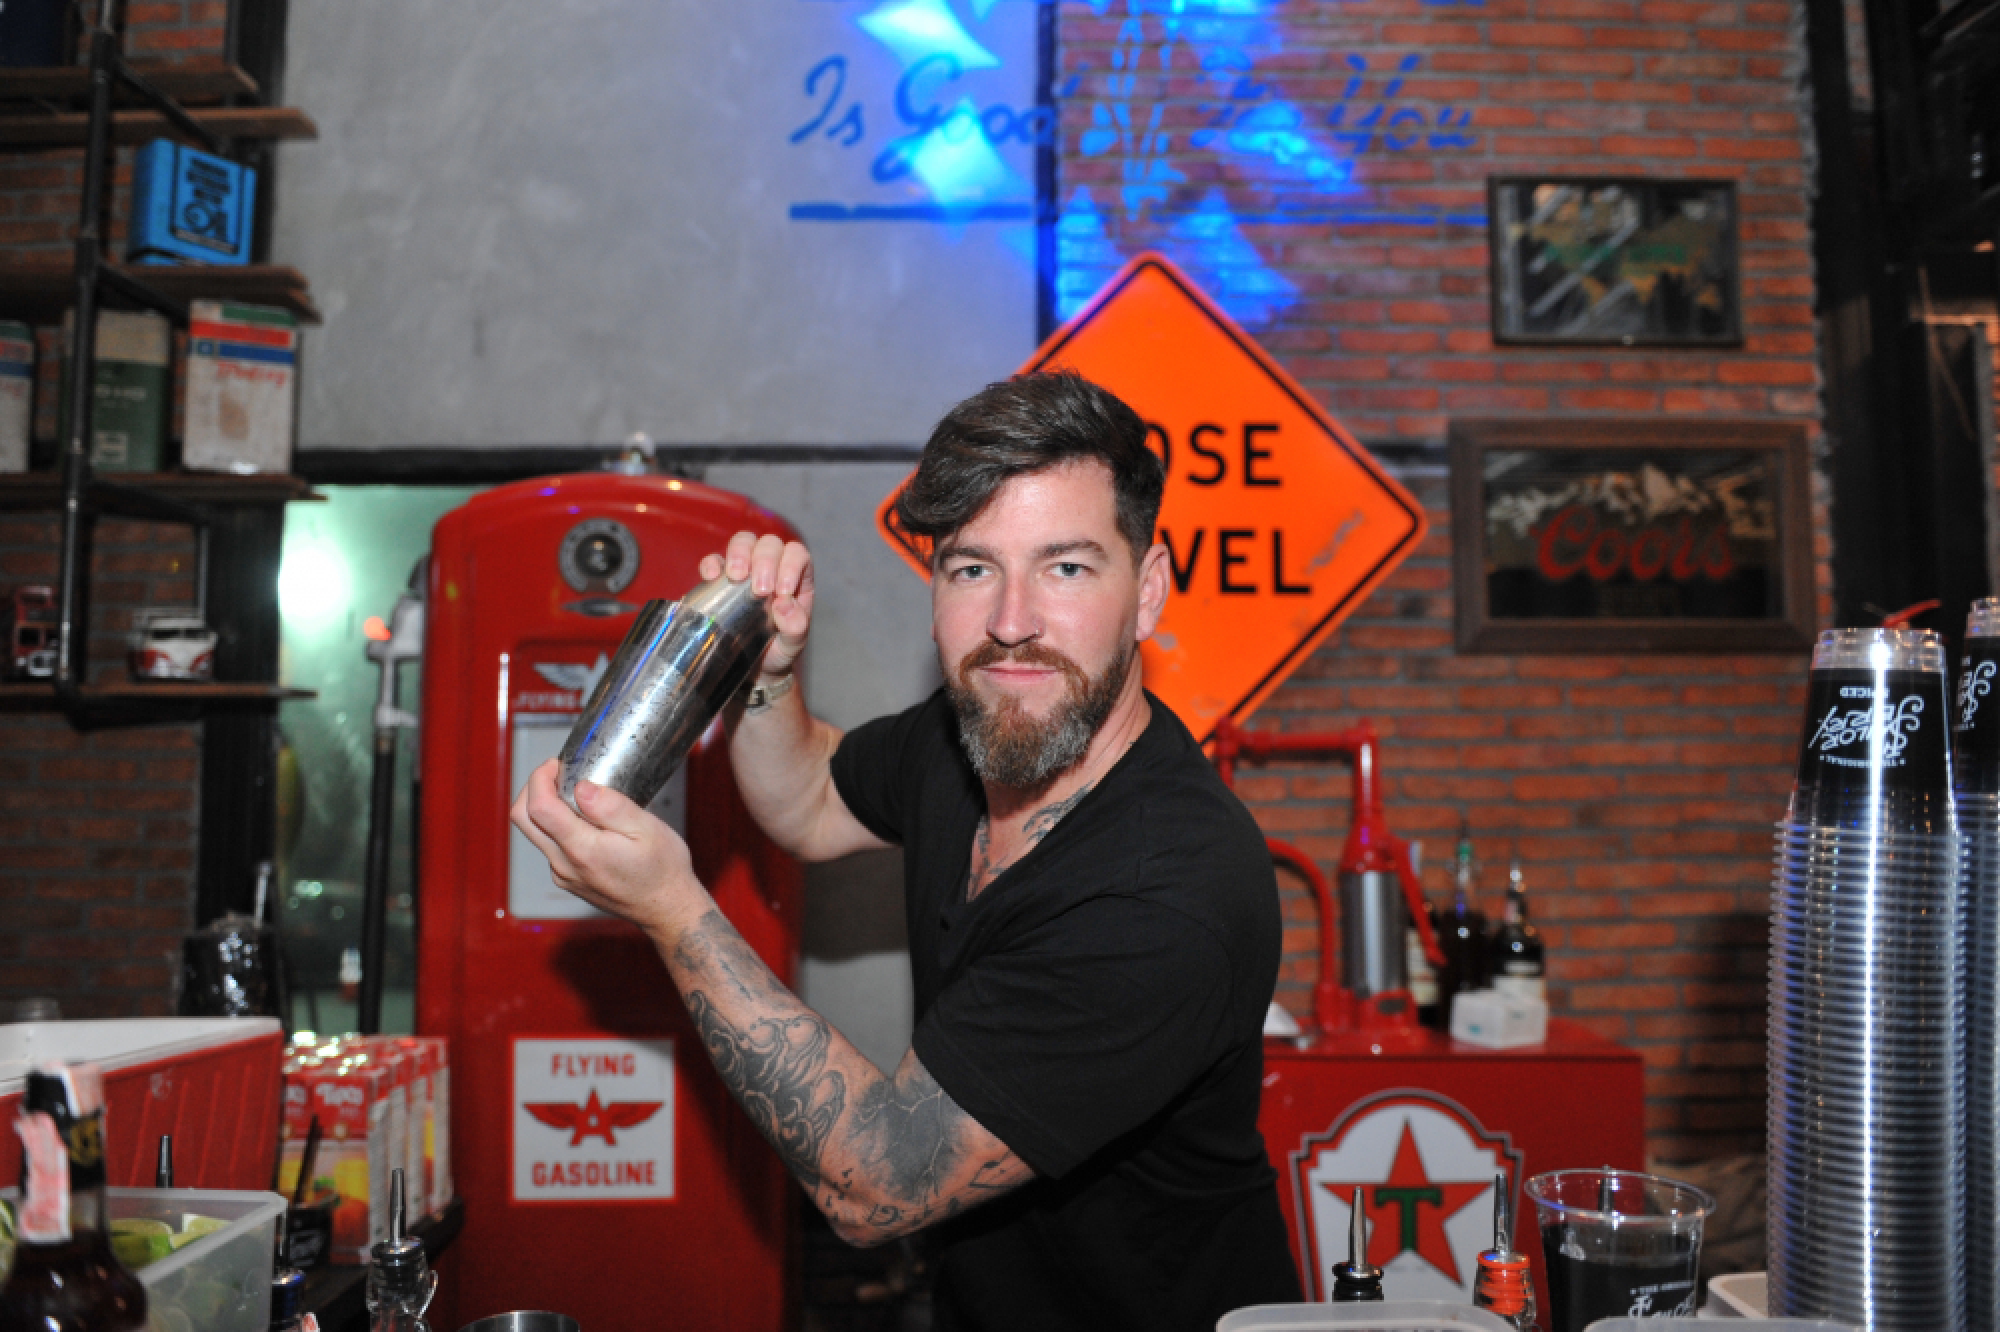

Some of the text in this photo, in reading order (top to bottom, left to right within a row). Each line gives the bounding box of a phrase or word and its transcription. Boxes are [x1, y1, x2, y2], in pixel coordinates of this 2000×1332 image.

[789, 54, 865, 148] Is
[1327, 53, 1478, 155] You
[1160, 528, 1313, 596] VEL
[1529, 504, 1735, 581] Coors
[551, 1052, 637, 1078] FLYING
[532, 1160, 657, 1188] GASOLINE
